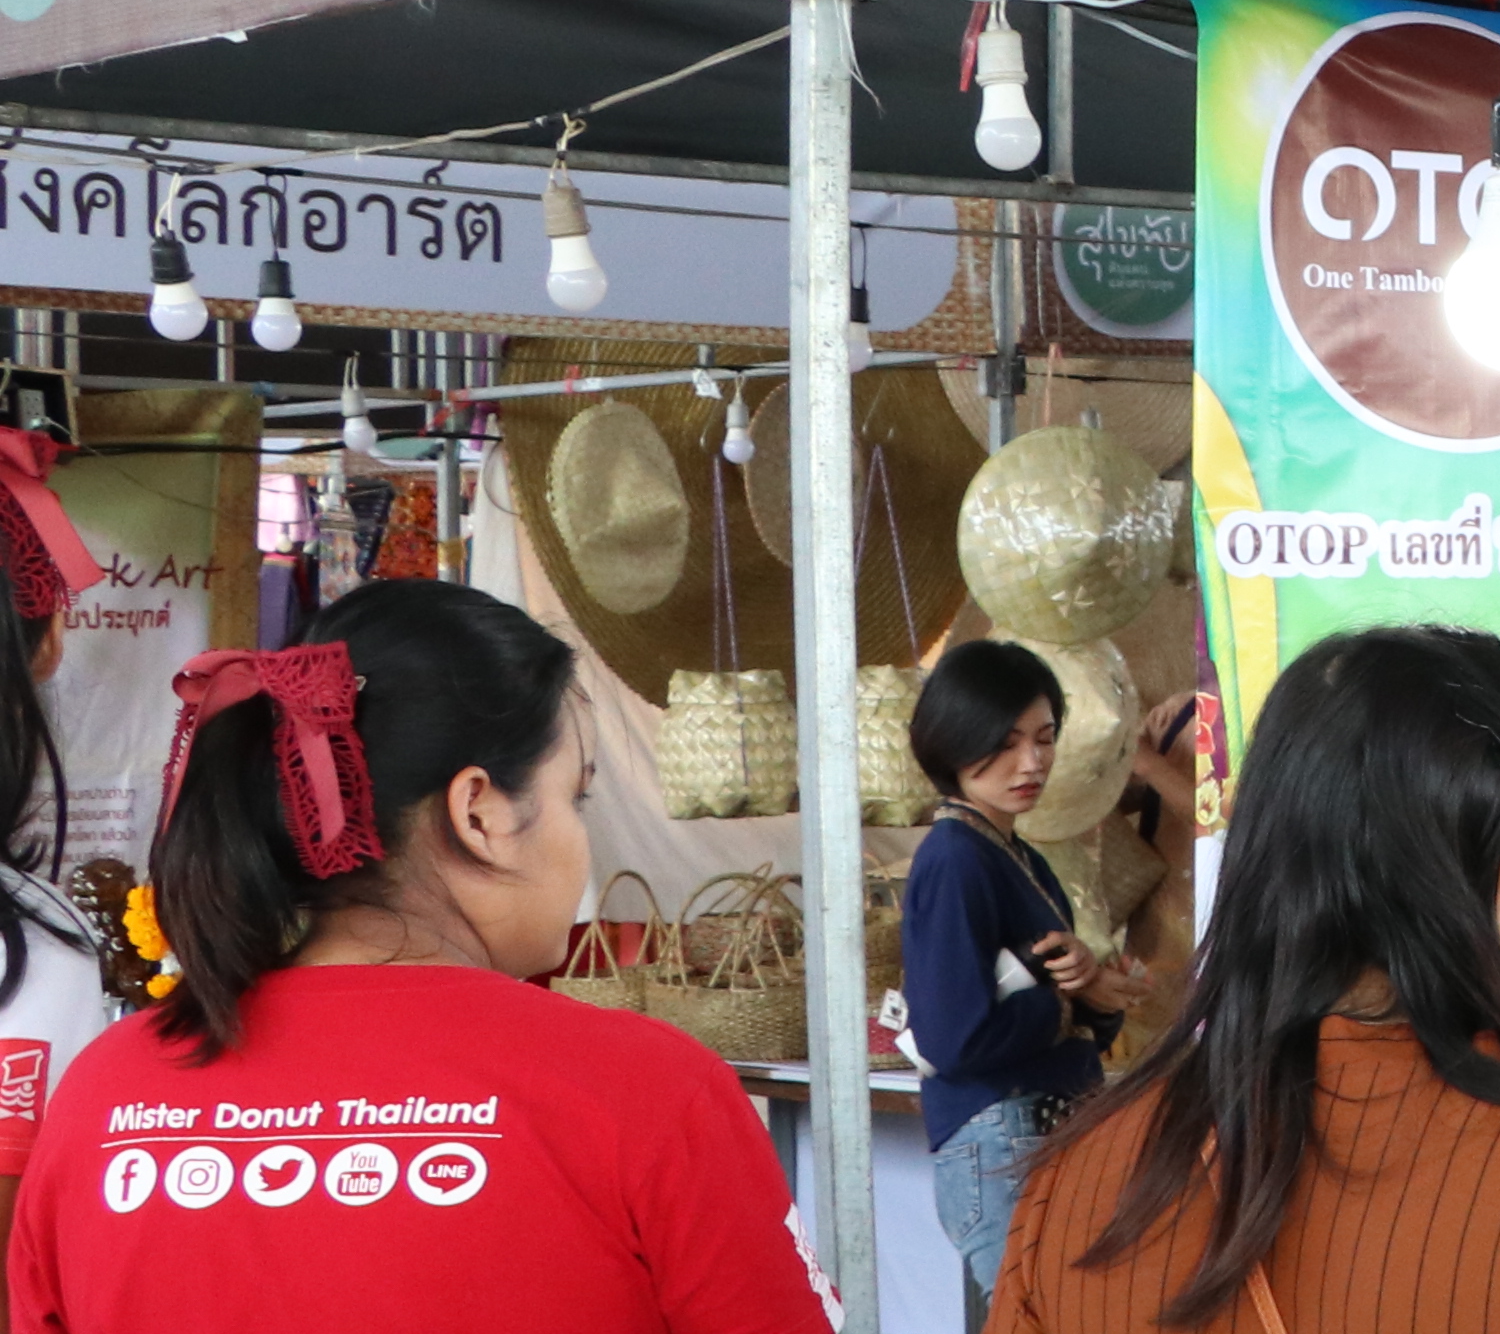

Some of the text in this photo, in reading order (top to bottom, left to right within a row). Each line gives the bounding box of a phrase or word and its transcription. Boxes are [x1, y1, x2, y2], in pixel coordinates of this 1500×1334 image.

[1303, 263, 1445, 295] One Tambo
[1227, 522, 1369, 567] OTOP
[1388, 505, 1482, 569] เลขที่
[149, 552, 227, 590] Art
[108, 1095, 498, 1135] Mister Donut Thailand
[347, 1150, 379, 1170] You
[426, 1163, 469, 1181] LINE
[339, 1170, 382, 1197] Tube
